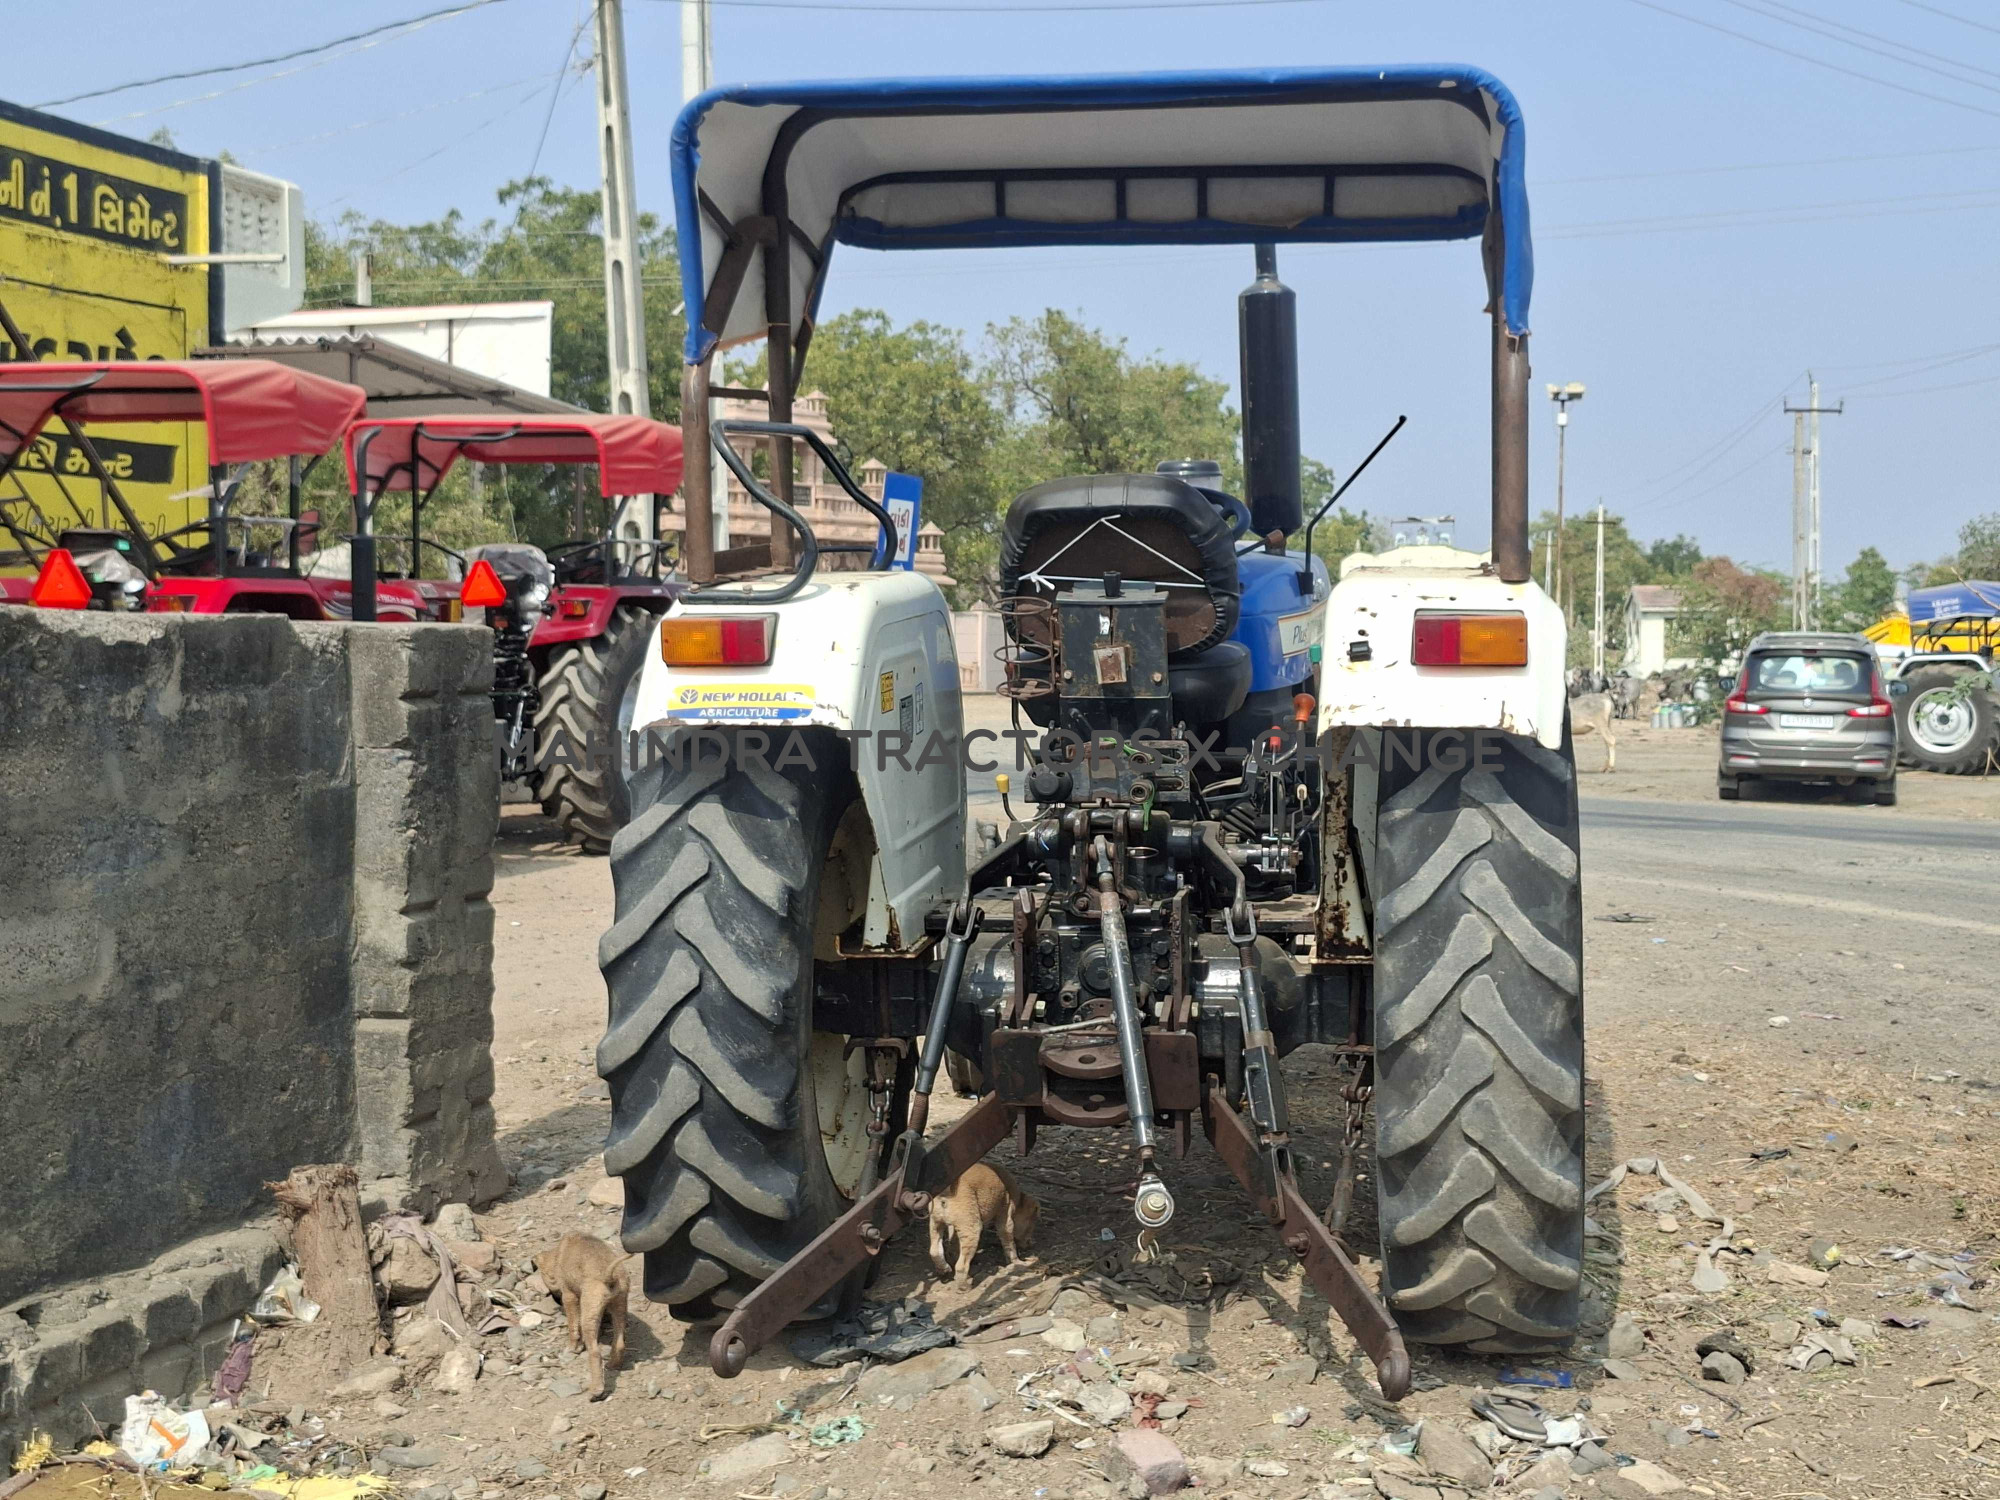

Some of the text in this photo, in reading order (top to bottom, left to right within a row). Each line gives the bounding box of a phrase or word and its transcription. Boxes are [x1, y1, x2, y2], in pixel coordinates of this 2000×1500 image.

[93, 184, 180, 248] સિમેન્ટ
[702, 691, 803, 702] NEW HOLLA
[699, 707, 780, 718] AGRICULTURE
